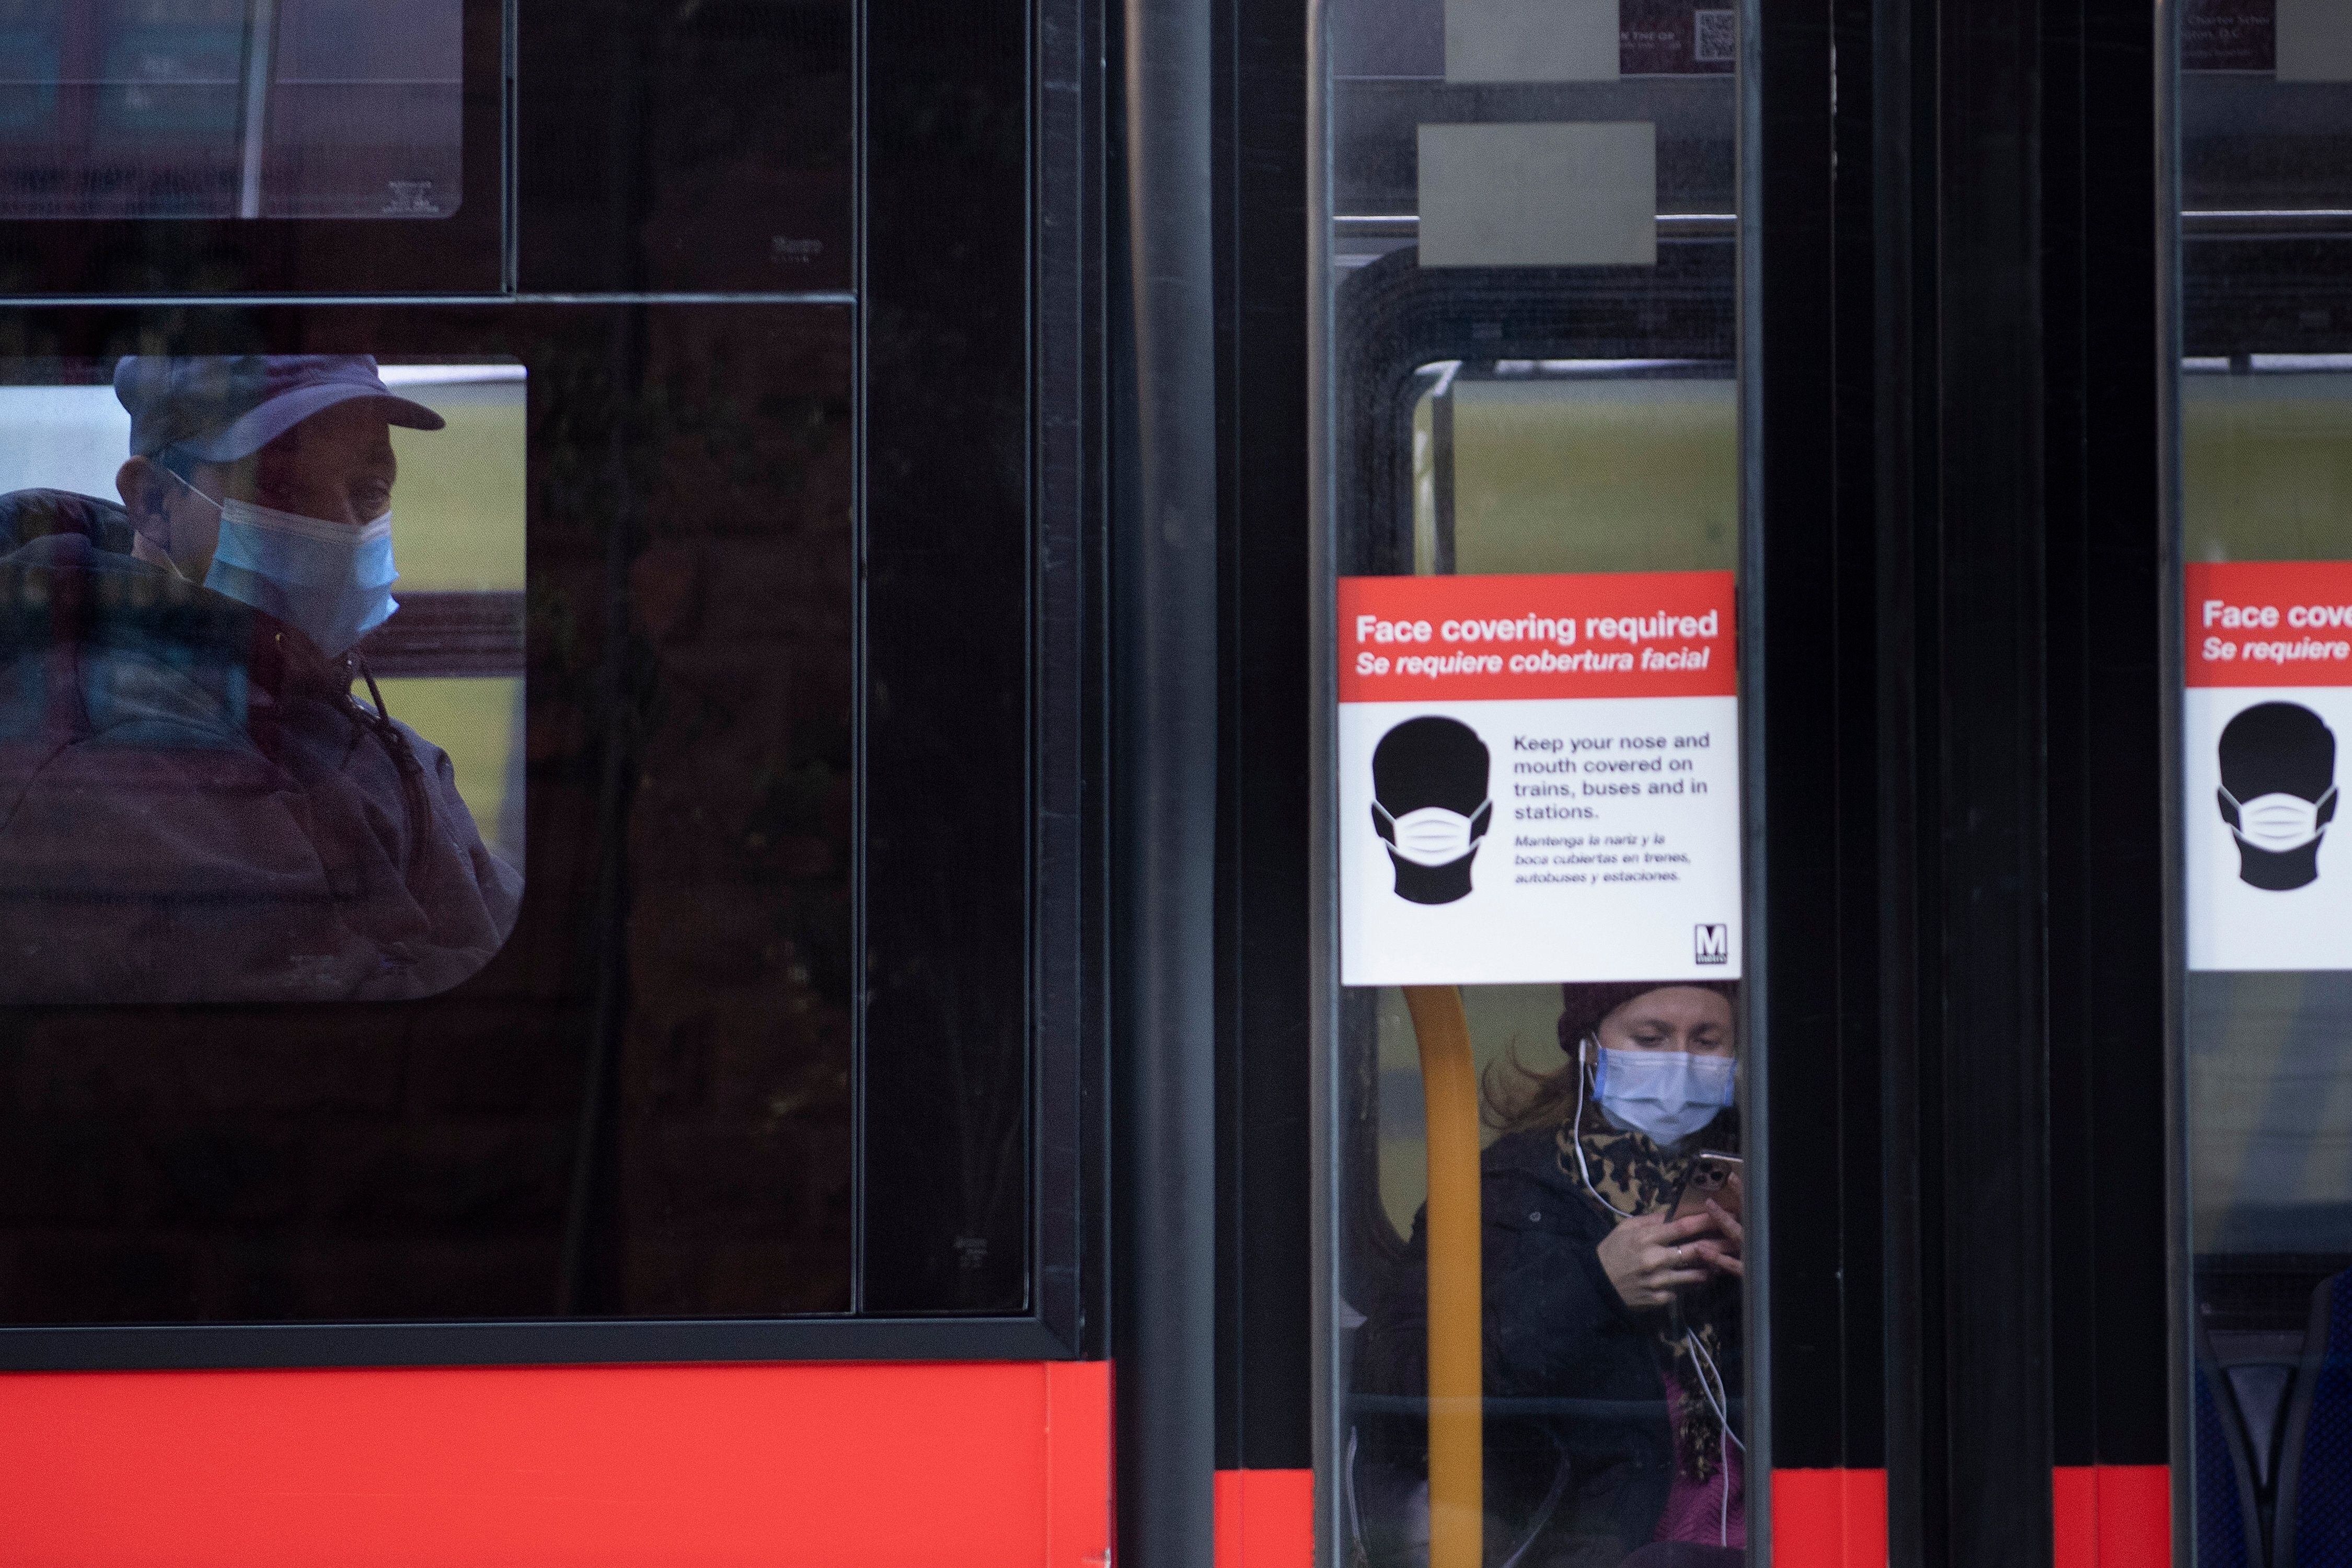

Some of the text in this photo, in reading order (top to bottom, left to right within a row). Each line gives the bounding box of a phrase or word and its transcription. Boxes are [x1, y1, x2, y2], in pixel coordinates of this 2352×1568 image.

[2204, 600, 2280, 628] Face
[1356, 609, 1718, 646] Face covering required
[2203, 636, 2350, 664] Se requiere
[1356, 647, 1710, 679] Se requiere cobertura facial
[1513, 732, 1710, 754] Keep your nose and
[1514, 756, 1693, 774] mouth covered on
[1514, 777, 1709, 799] trains, buses and in
[1514, 803, 1599, 821] stations.
[1587, 835, 1601, 847] la
[1640, 835, 1651, 848] y
[1652, 833, 1666, 846] la
[1590, 874, 1599, 886] y
